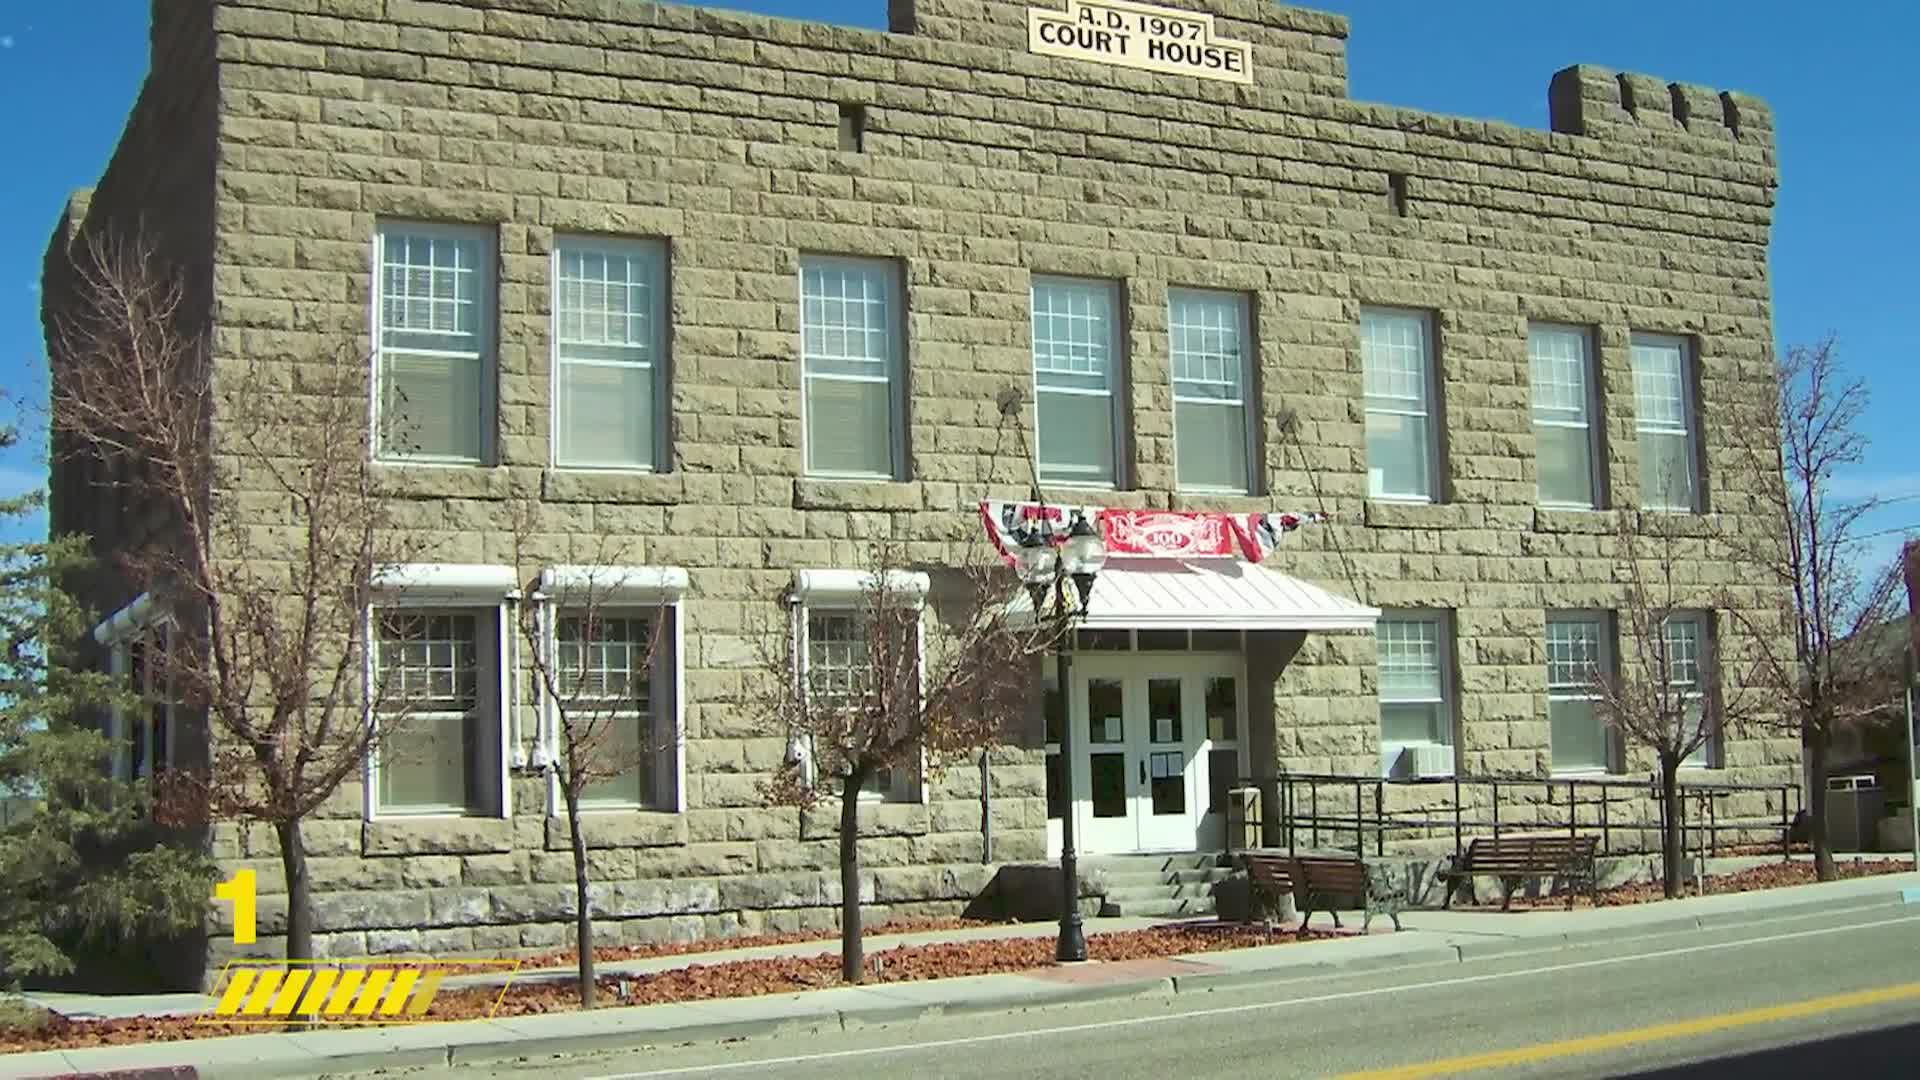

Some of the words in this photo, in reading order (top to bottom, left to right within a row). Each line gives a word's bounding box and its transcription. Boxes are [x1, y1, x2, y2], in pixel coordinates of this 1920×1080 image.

[1079, 8, 1130, 30] A.D.
[1139, 17, 1201, 41] 1907
[1040, 23, 1130, 55] COURT
[1148, 39, 1241, 73] HOUSE
